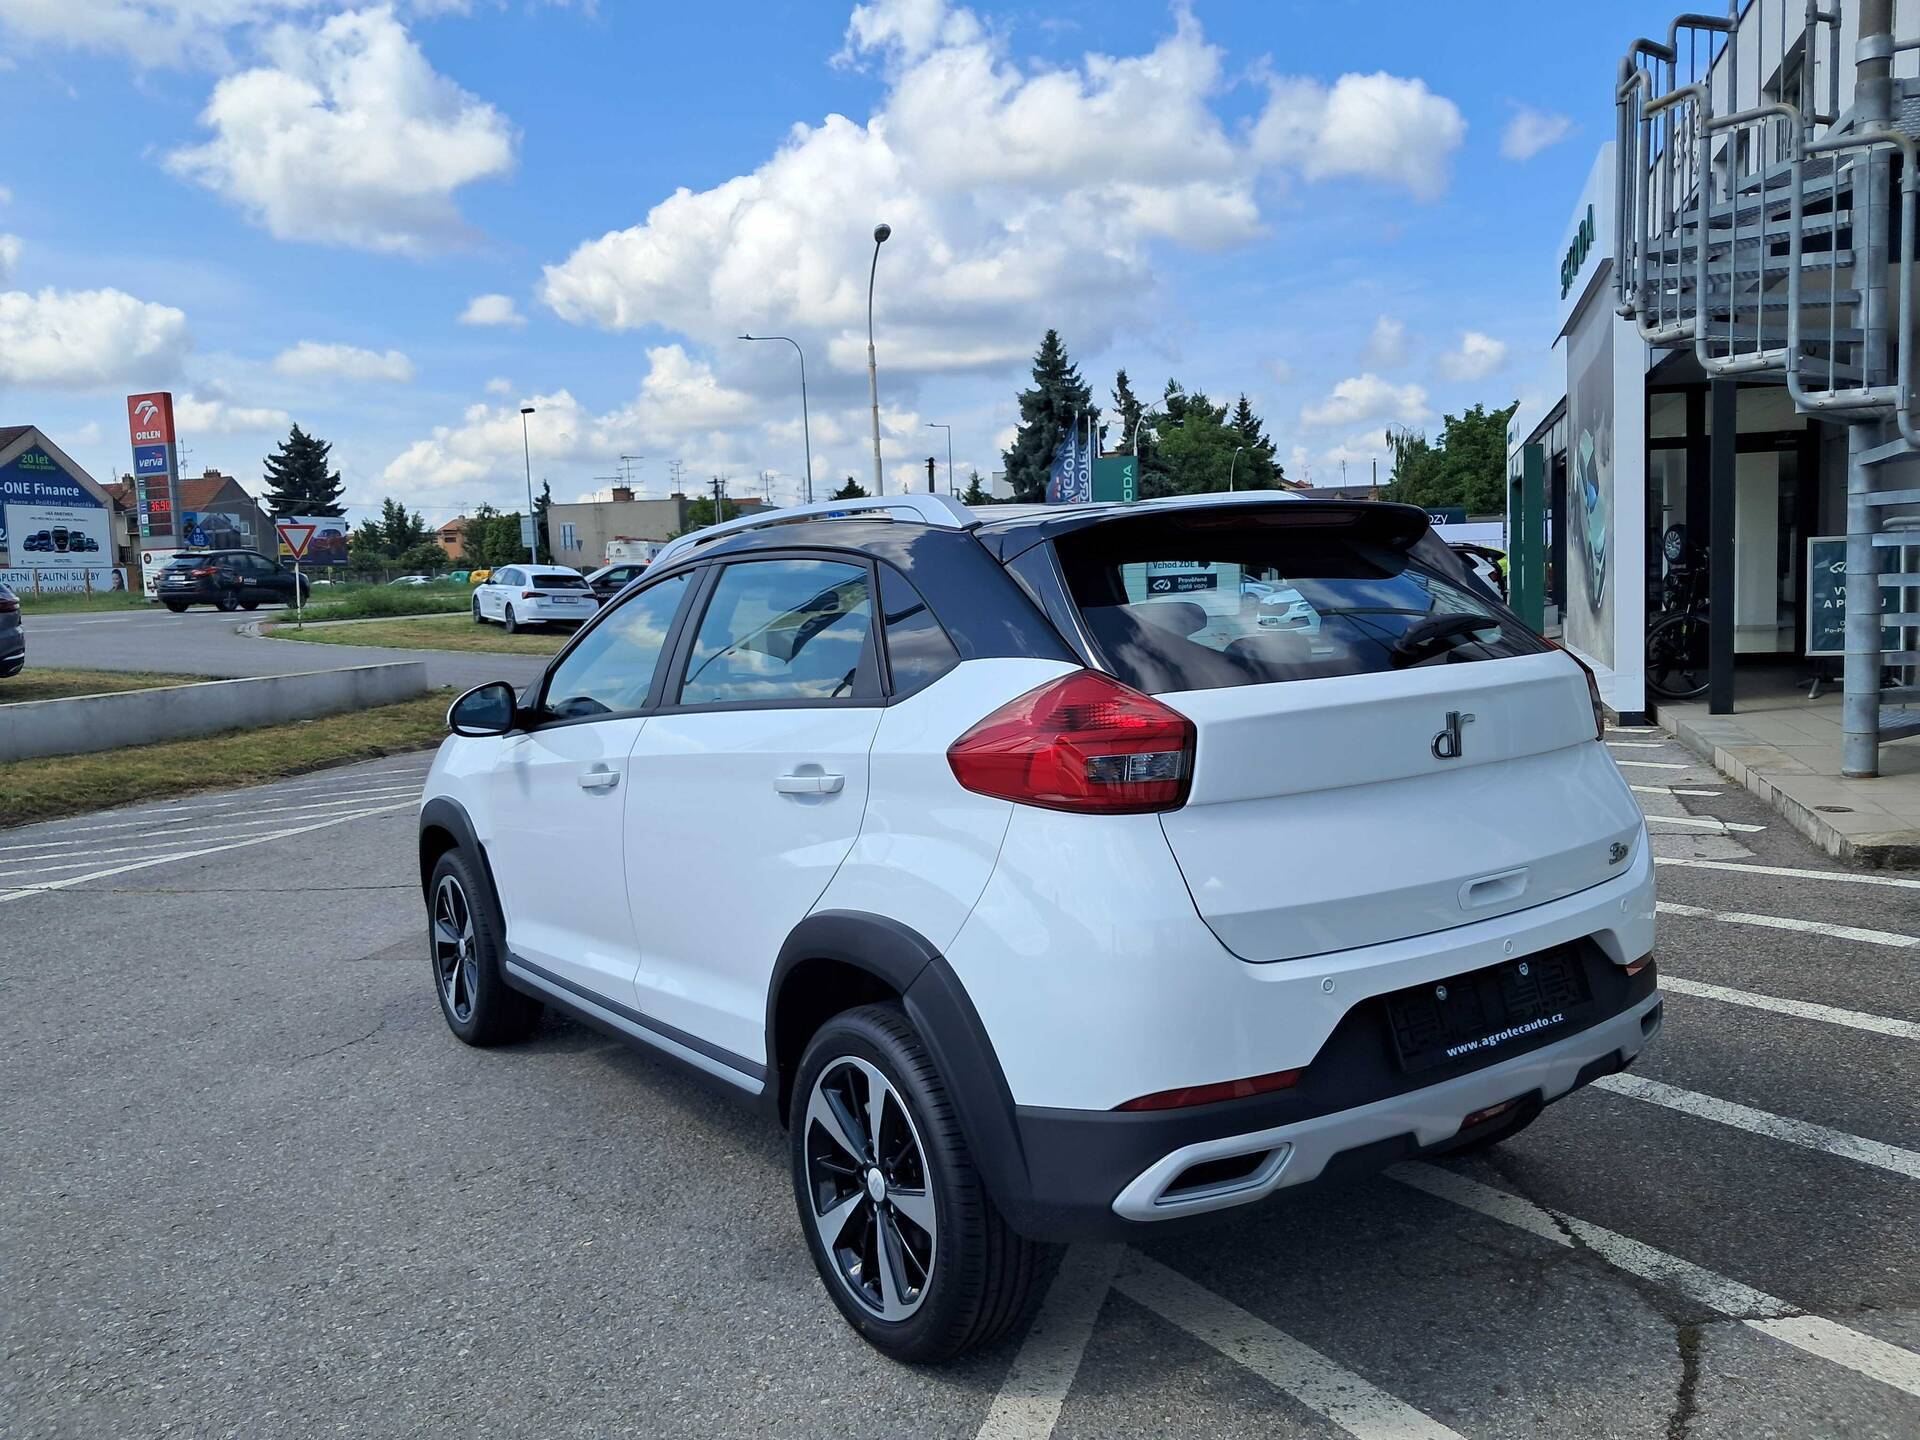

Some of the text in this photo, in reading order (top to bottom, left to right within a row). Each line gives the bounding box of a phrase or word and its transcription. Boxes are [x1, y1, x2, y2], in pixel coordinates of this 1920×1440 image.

[136, 430, 161, 440] ORLEN
[21, 453, 49, 464] 20 let
[139, 457, 163, 468] verva
[1123, 463, 1133, 503] ODA
[34, 483, 80, 496] Finance
[1429, 514, 1449, 526] ozy
[0, 571, 100, 582] PLETNÍ EALITNÍ SLUBY
[1823, 600, 1832, 608] A
[1446, 1013, 1564, 1056] www.agrotecauto.cz
